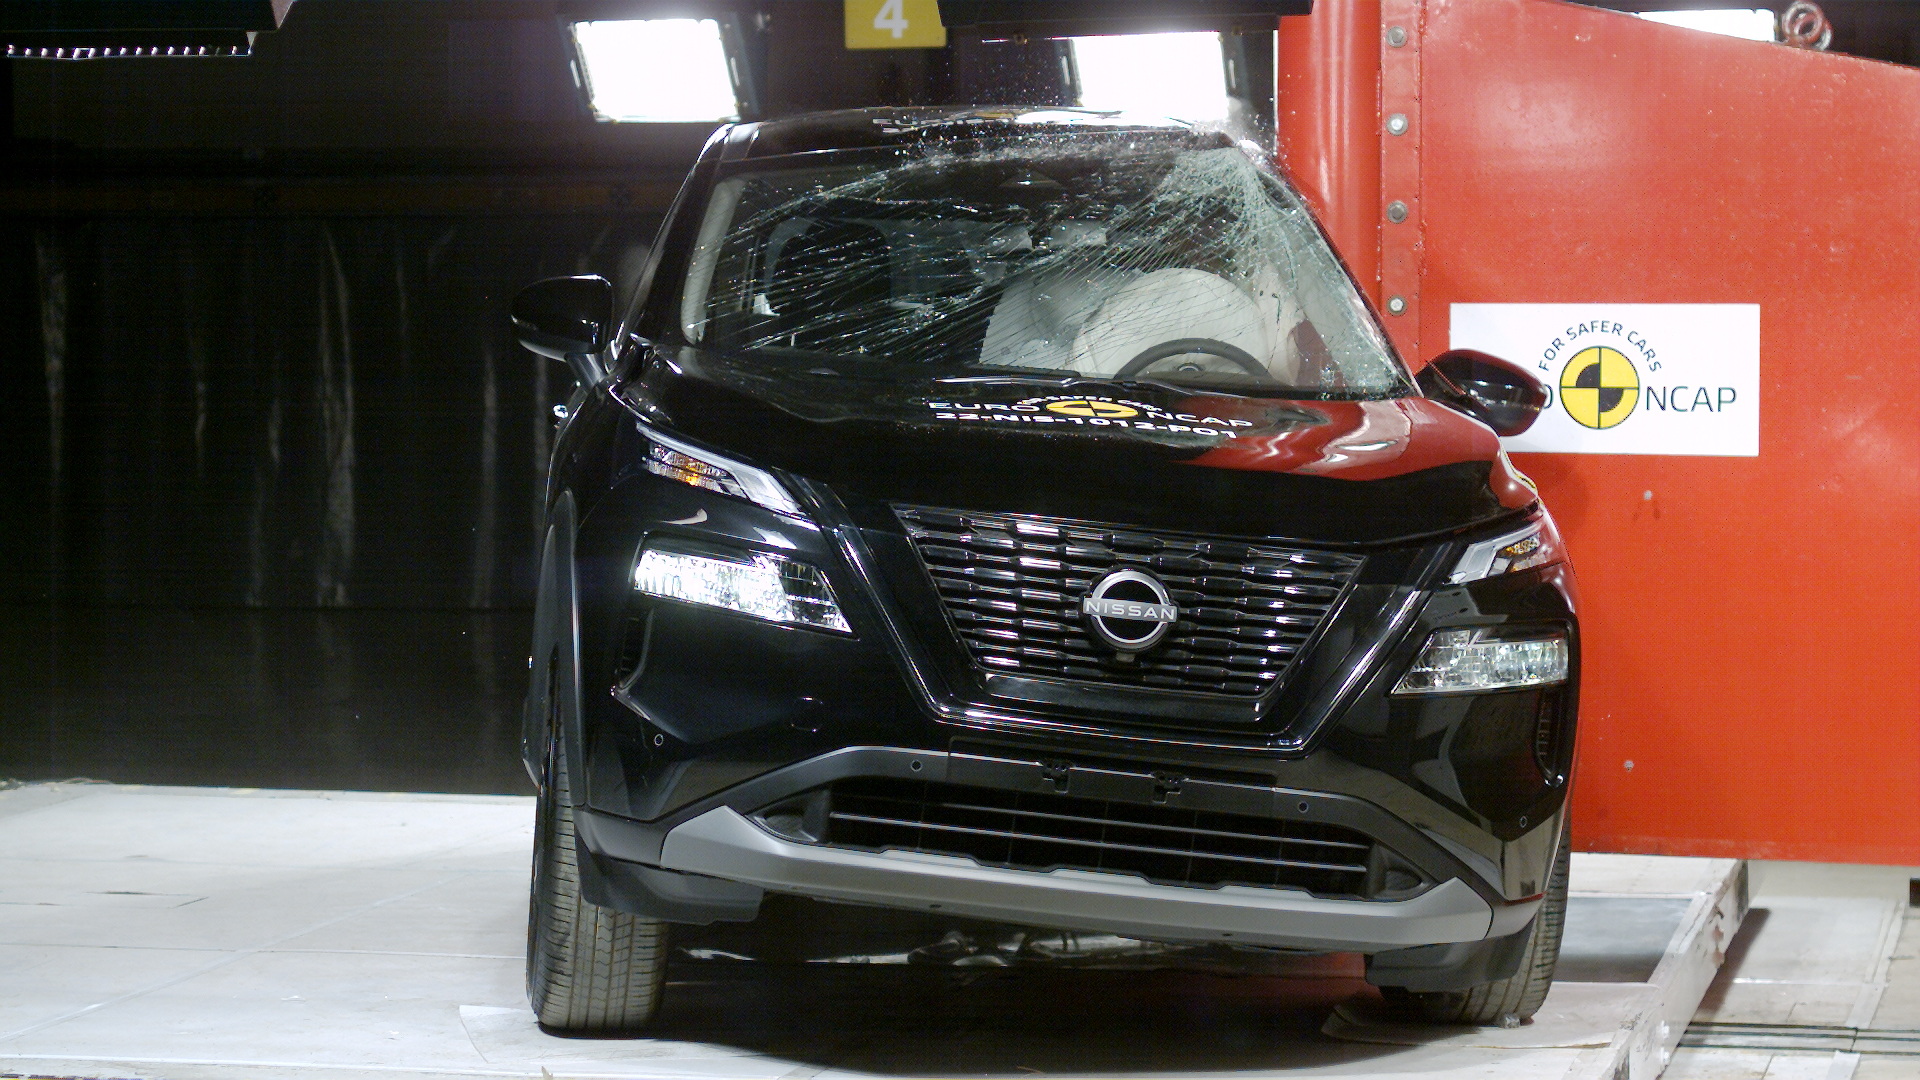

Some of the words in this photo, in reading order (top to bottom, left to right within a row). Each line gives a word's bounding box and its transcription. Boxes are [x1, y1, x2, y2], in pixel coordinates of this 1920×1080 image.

[873, 0, 908, 38] 4
[1538, 338, 1565, 371] FOR
[1566, 320, 1623, 340] SAFER
[1627, 331, 1662, 372] CARS
[1646, 386, 1737, 412] NCAP
[928, 402, 1040, 412] EURO
[1146, 411, 1253, 427] NCAP
[1086, 601, 1175, 620] NISSAN
